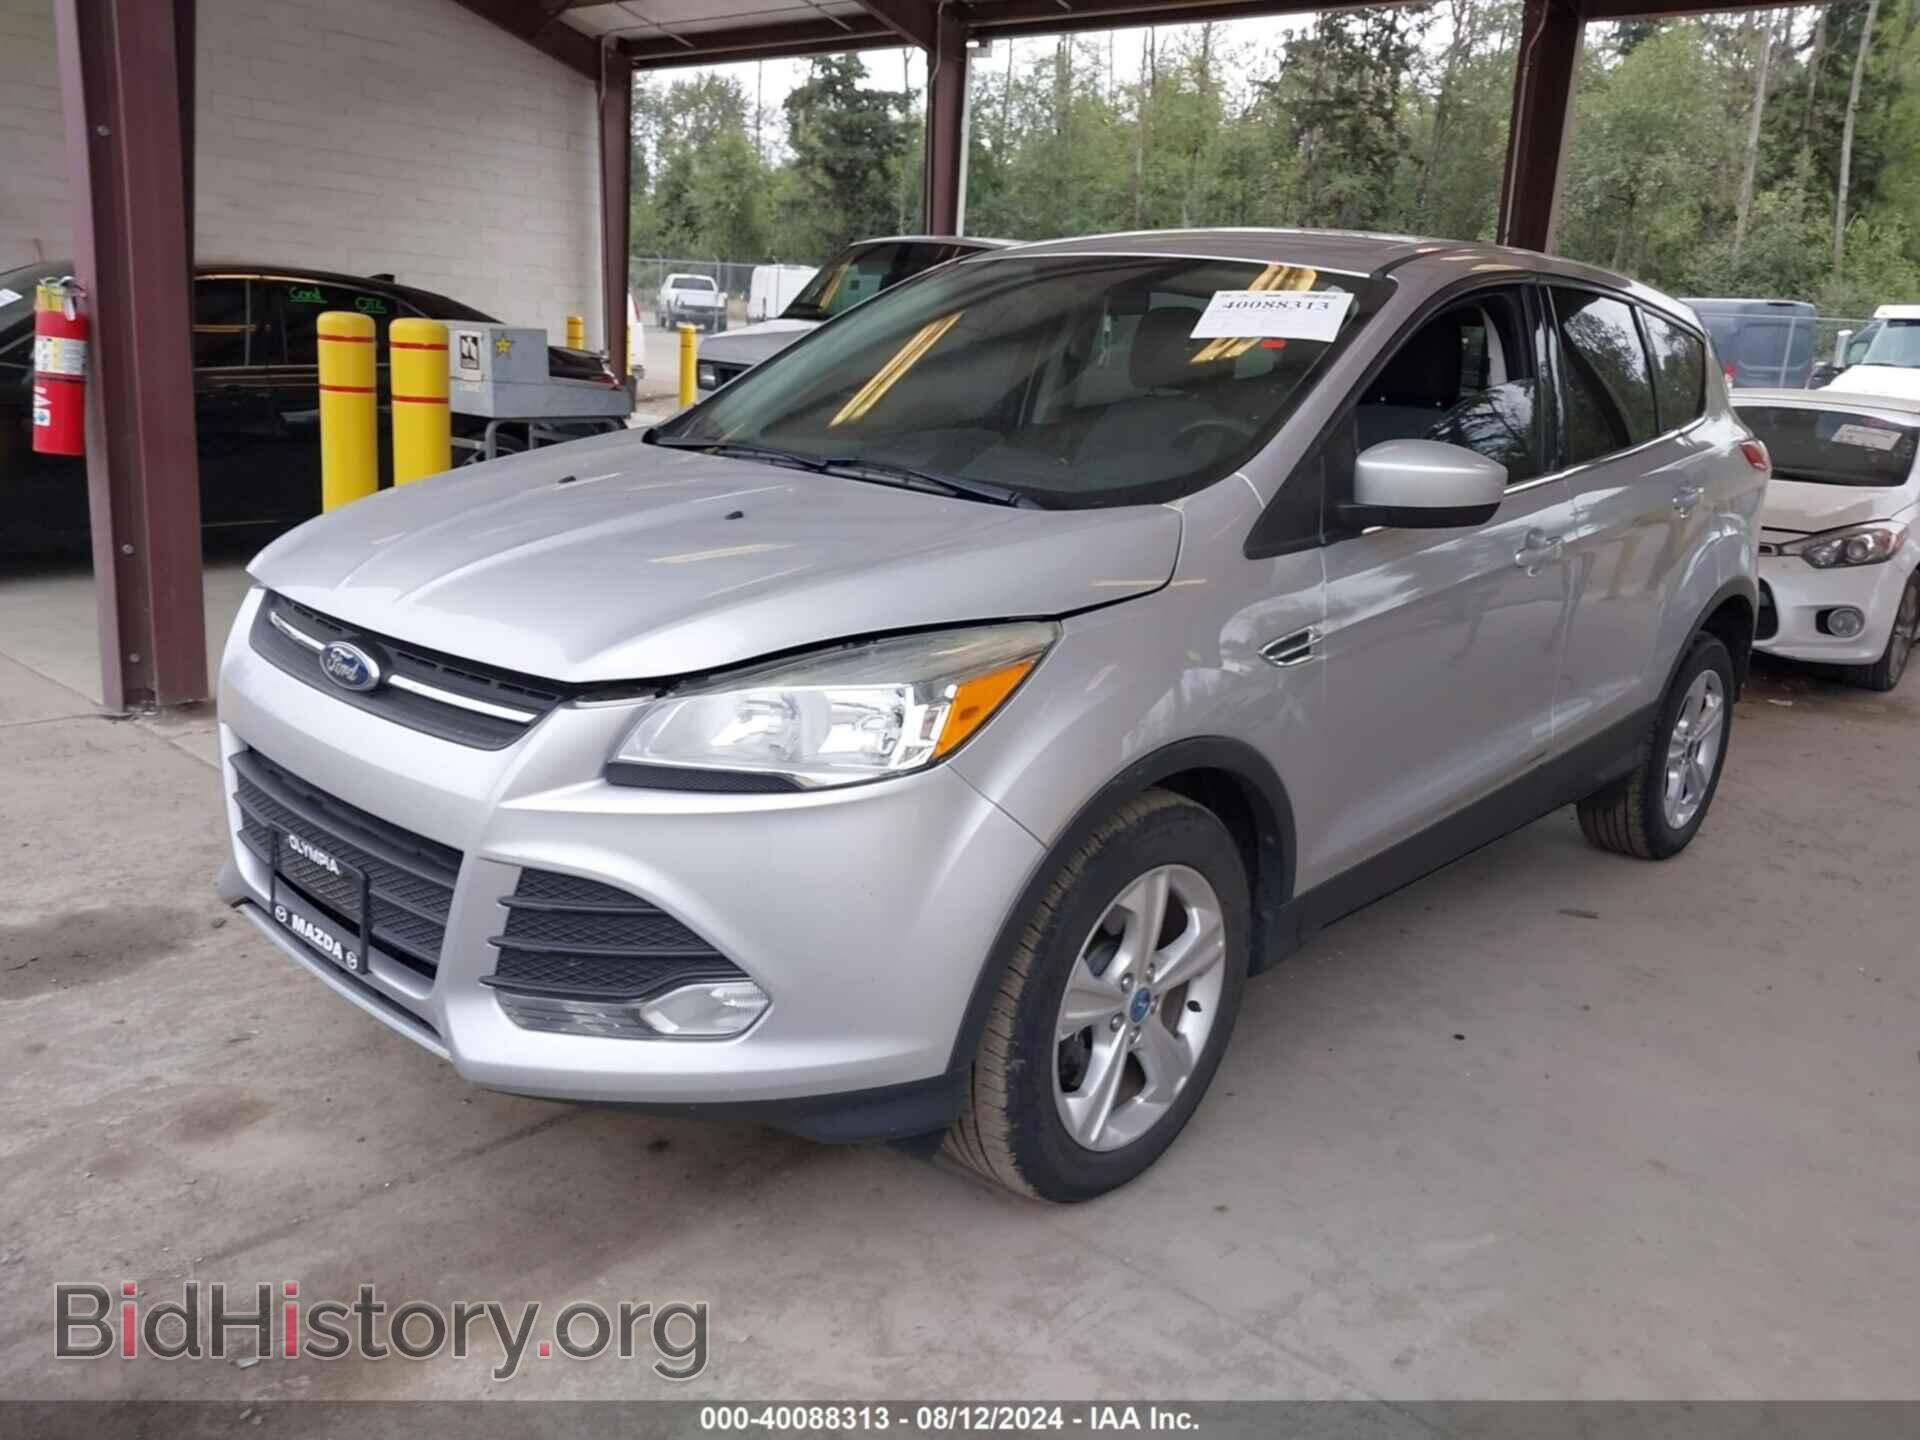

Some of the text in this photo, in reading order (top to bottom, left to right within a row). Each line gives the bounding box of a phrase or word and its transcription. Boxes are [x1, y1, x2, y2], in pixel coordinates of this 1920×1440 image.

[1222, 300, 1330, 311] 40088313
[327, 647, 360, 680] Ford
[288, 834, 340, 875] OLYMPIA
[291, 914, 343, 960] MAZDA
